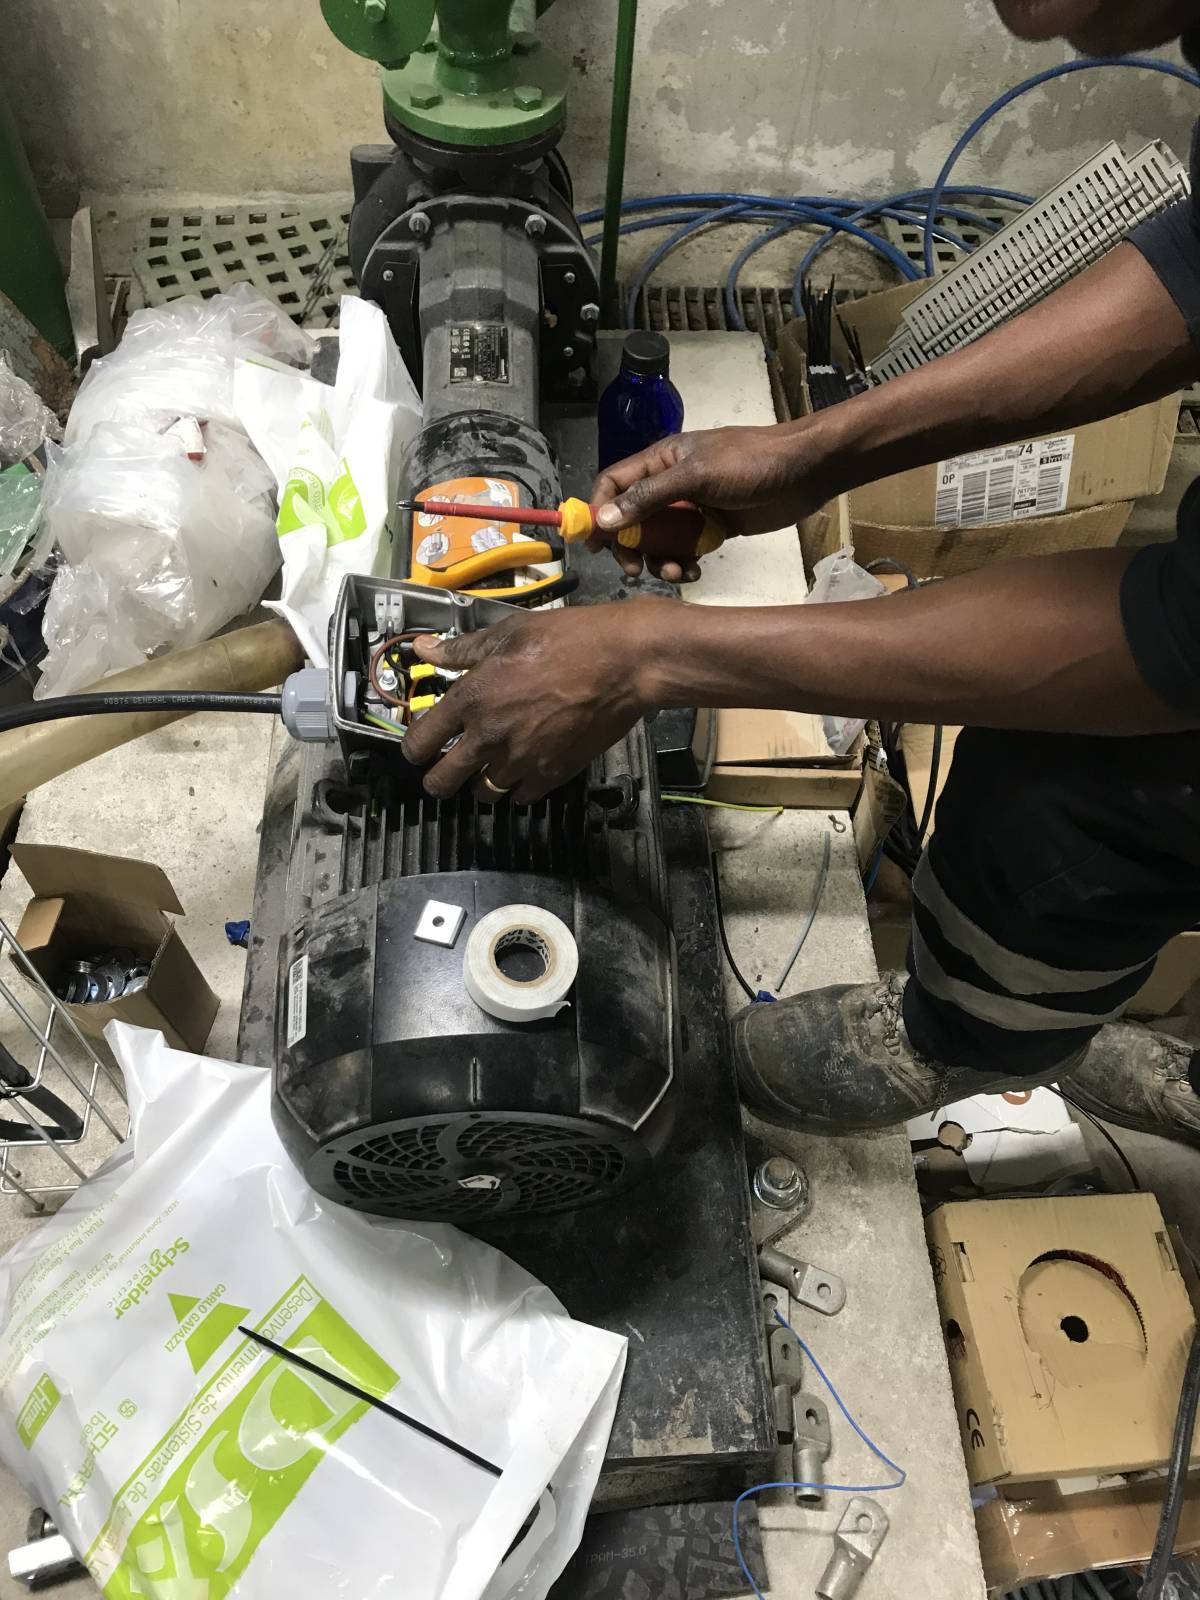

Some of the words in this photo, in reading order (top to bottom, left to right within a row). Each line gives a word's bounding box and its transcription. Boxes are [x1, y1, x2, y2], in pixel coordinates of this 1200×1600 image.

[1018, 443, 1032, 456] 74
[114, 1236, 190, 1320] Schneider
[195, 1281, 227, 1315] CARLO
[163, 1311, 201, 1352] GAVAZZI
[213, 1286, 313, 1393] Desenvovimento
[196, 1393, 220, 1418] de
[142, 1414, 203, 1483] Sistemas
[966, 1408, 985, 1451] CE
[125, 1480, 151, 1507] de
